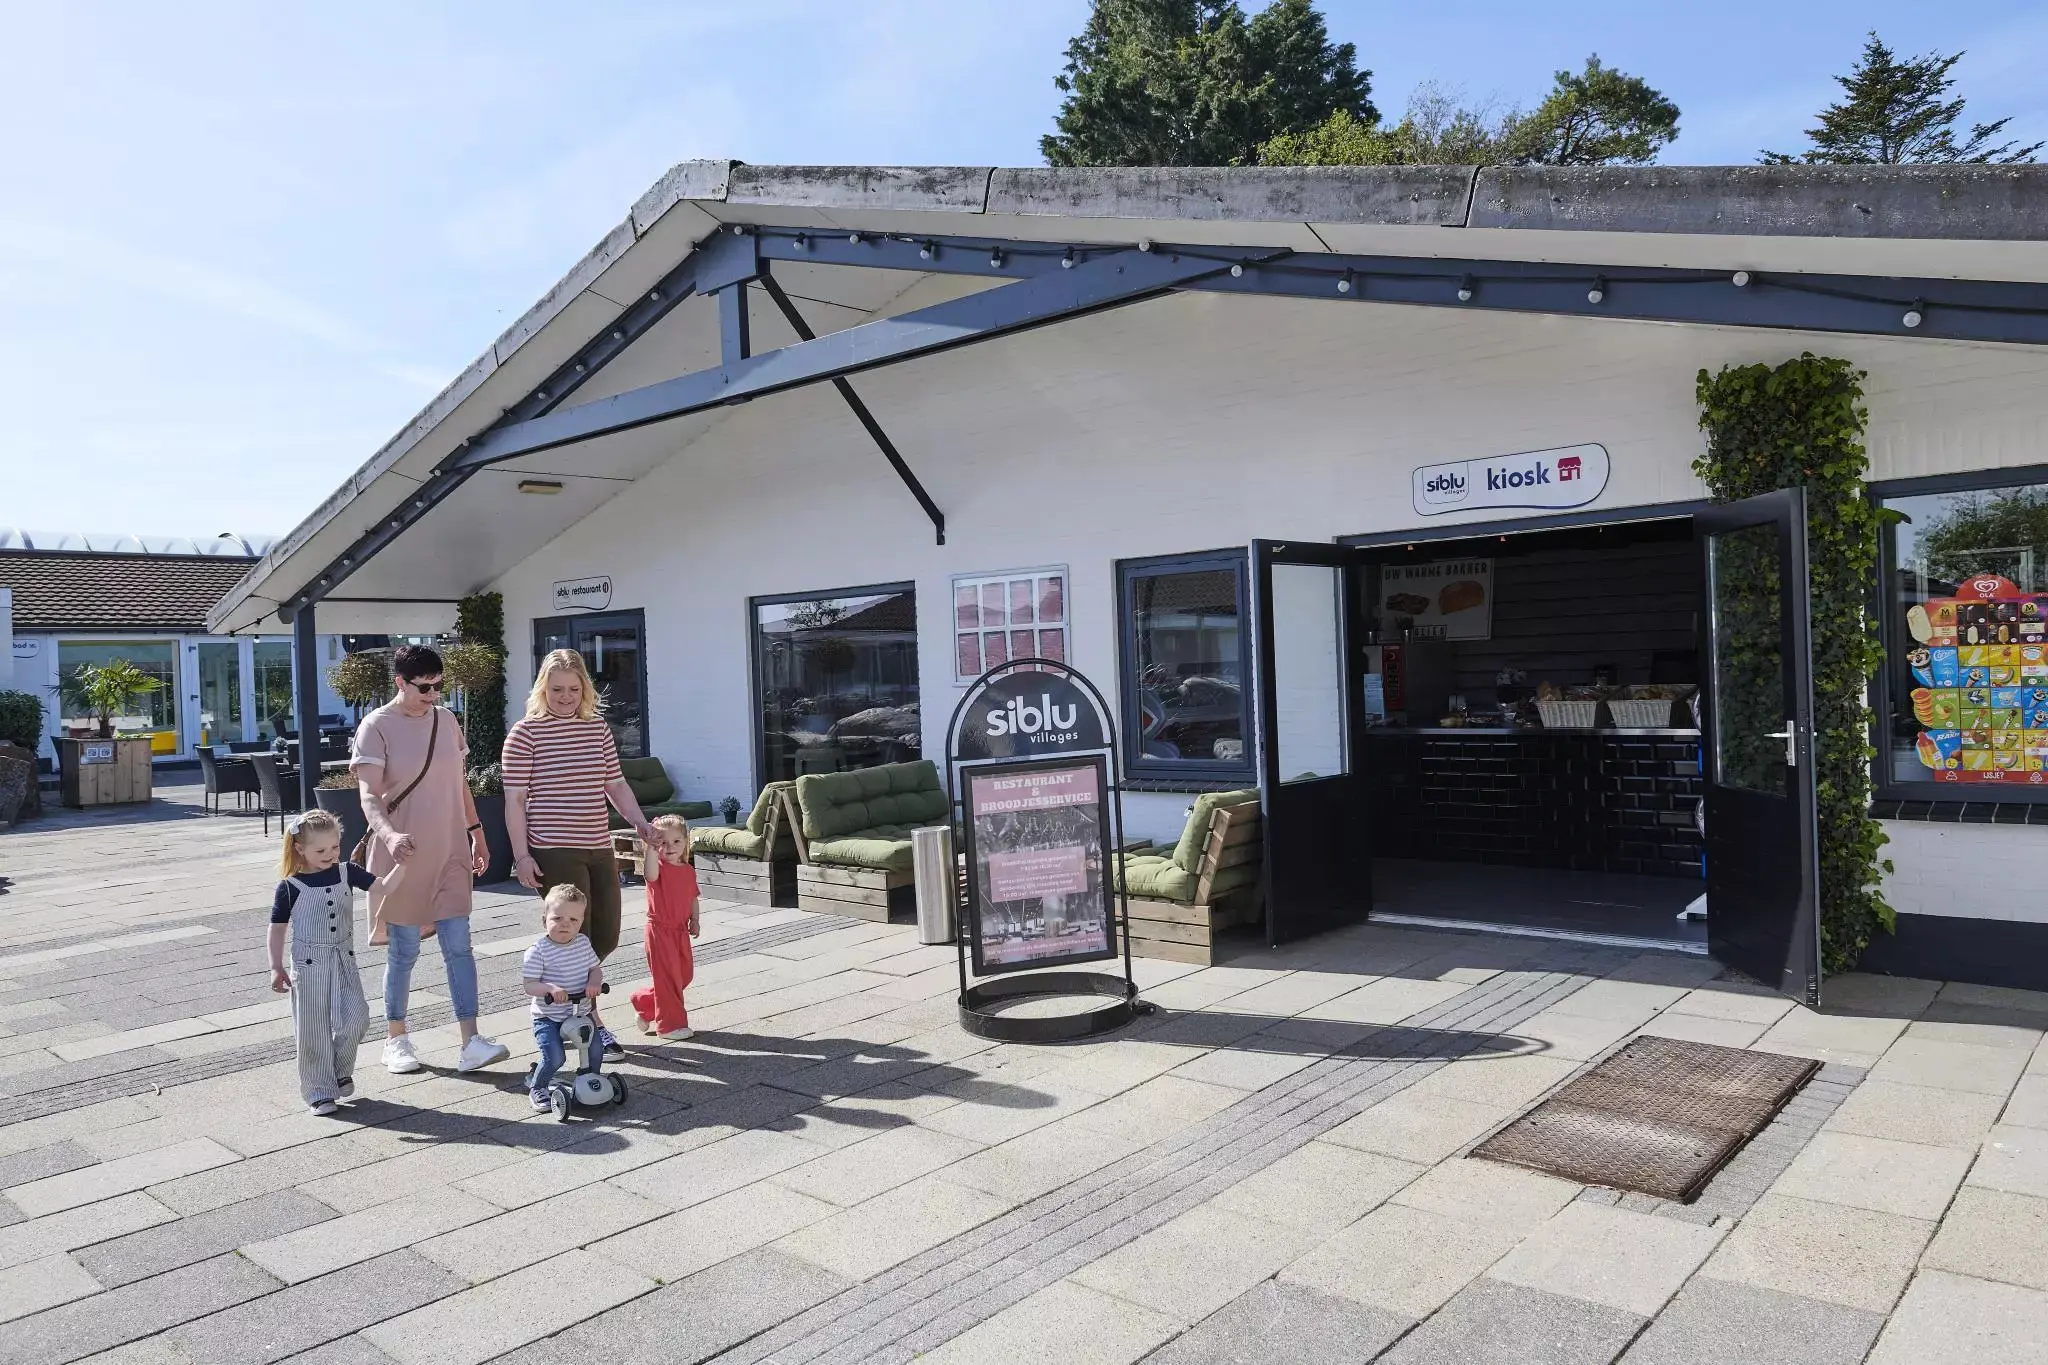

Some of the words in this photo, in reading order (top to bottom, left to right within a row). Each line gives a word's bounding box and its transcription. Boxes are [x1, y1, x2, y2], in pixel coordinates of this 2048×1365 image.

[1427, 473, 1465, 492] siblu
[1487, 462, 1551, 490] kiosk
[1405, 565, 1441, 579] WARME
[1446, 562, 1487, 575] BAKKER
[572, 584, 601, 595] restaurant
[986, 694, 1076, 736] siblu
[1030, 731, 1078, 744] villages
[993, 774, 1074, 790] RESTAURANT
[1031, 787, 1040, 797] &
[980, 792, 1092, 812] BROODJESSERVICE
